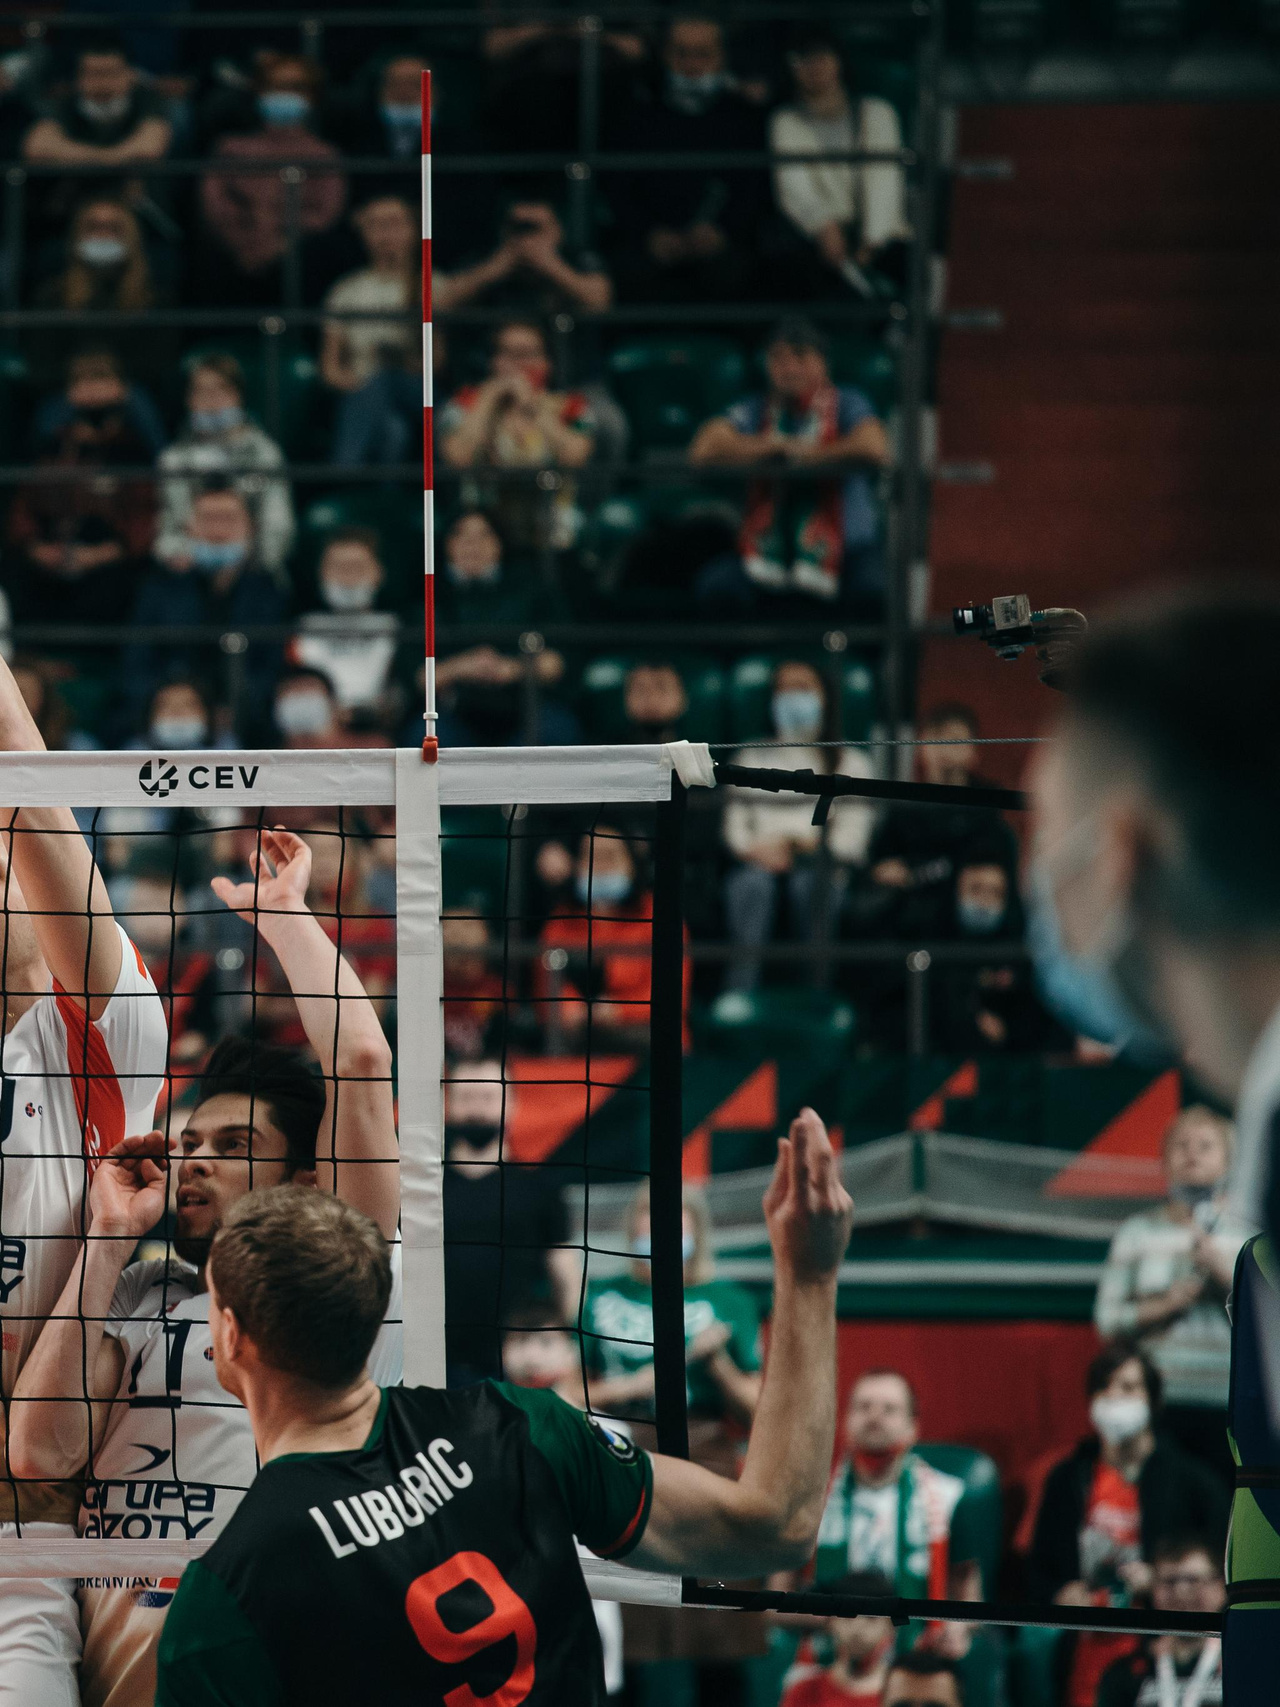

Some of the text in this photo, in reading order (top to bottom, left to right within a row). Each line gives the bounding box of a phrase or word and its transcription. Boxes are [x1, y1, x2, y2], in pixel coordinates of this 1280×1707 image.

[188, 766, 260, 789] CEV
[308, 1437, 474, 1559] LUBURIC
[405, 1551, 537, 1707] 9
